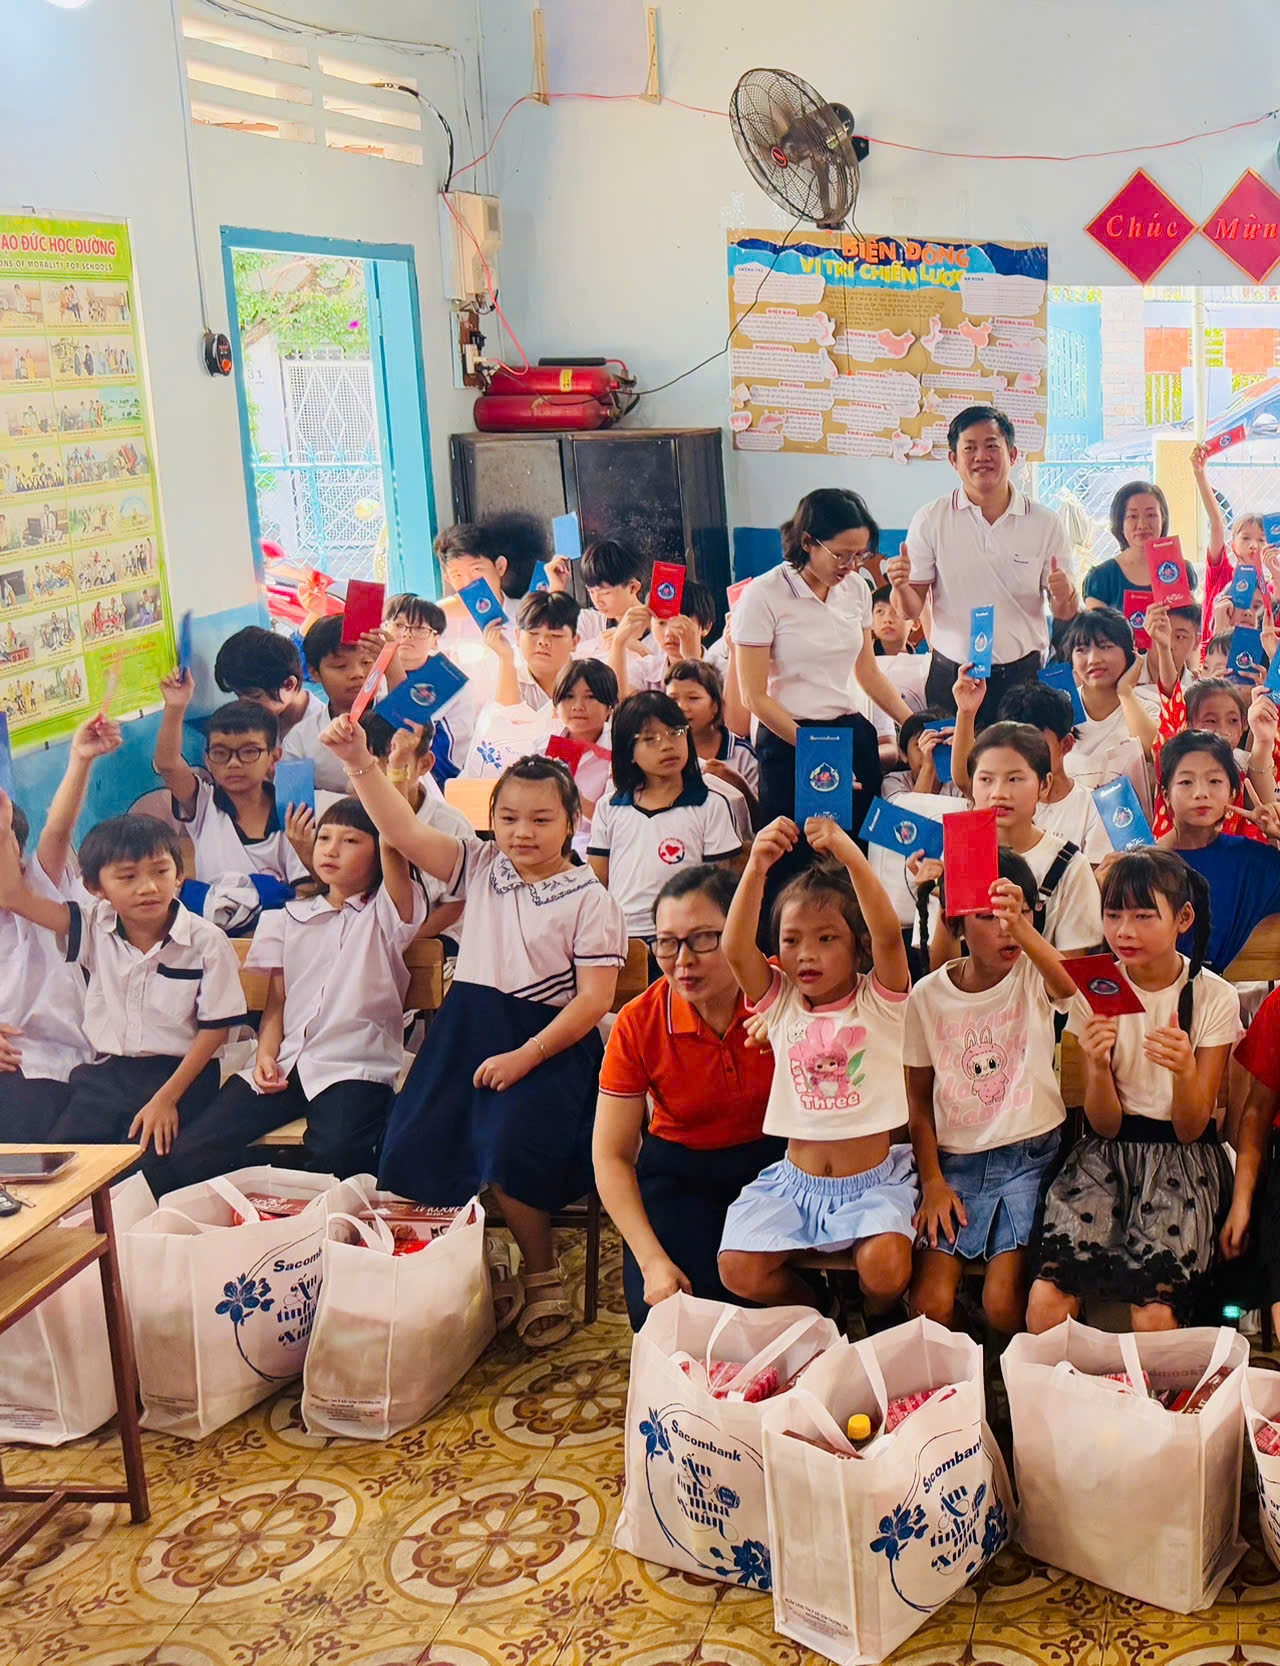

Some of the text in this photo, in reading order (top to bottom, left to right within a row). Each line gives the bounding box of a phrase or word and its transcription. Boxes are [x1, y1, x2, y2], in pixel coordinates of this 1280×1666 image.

[1106, 213, 1178, 239] Chúc
[0, 232, 116, 256] ẠO ĐỨC HỌC ĐƯỜNG
[905, 240, 971, 268] ĐÔNG
[16, 260, 25, 268] OF
[28, 261, 64, 270] MORALITY
[66, 262, 80, 270] FOR
[82, 263, 113, 272] SCHOOLS
[800, 1091, 860, 1111] Three
[273, 1246, 323, 1272] Sacomb
[671, 1419, 742, 1462] Sacombank
